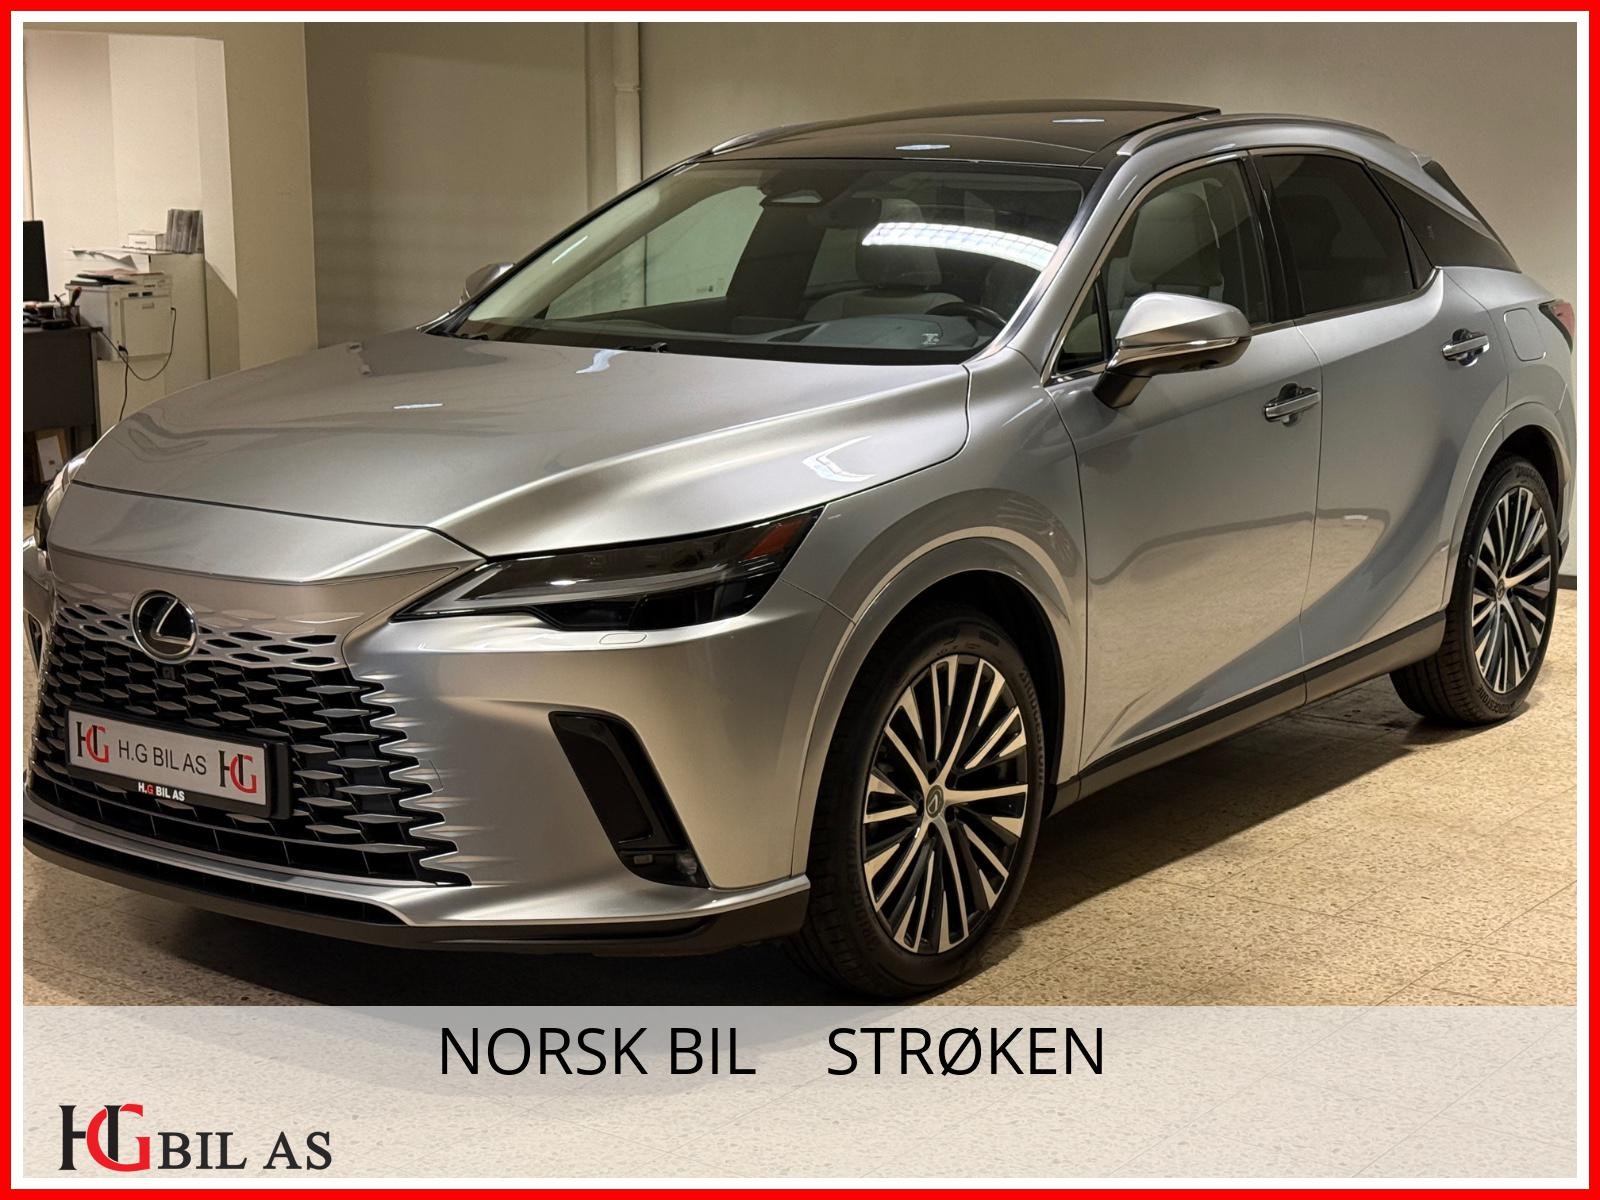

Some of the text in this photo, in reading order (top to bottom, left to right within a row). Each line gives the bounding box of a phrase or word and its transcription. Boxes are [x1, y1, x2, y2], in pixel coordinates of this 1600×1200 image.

[118, 740, 148, 763] H.G
[153, 746, 180, 770] BIL
[182, 753, 207, 775] AS
[138, 782, 186, 802] H.G BIL AS
